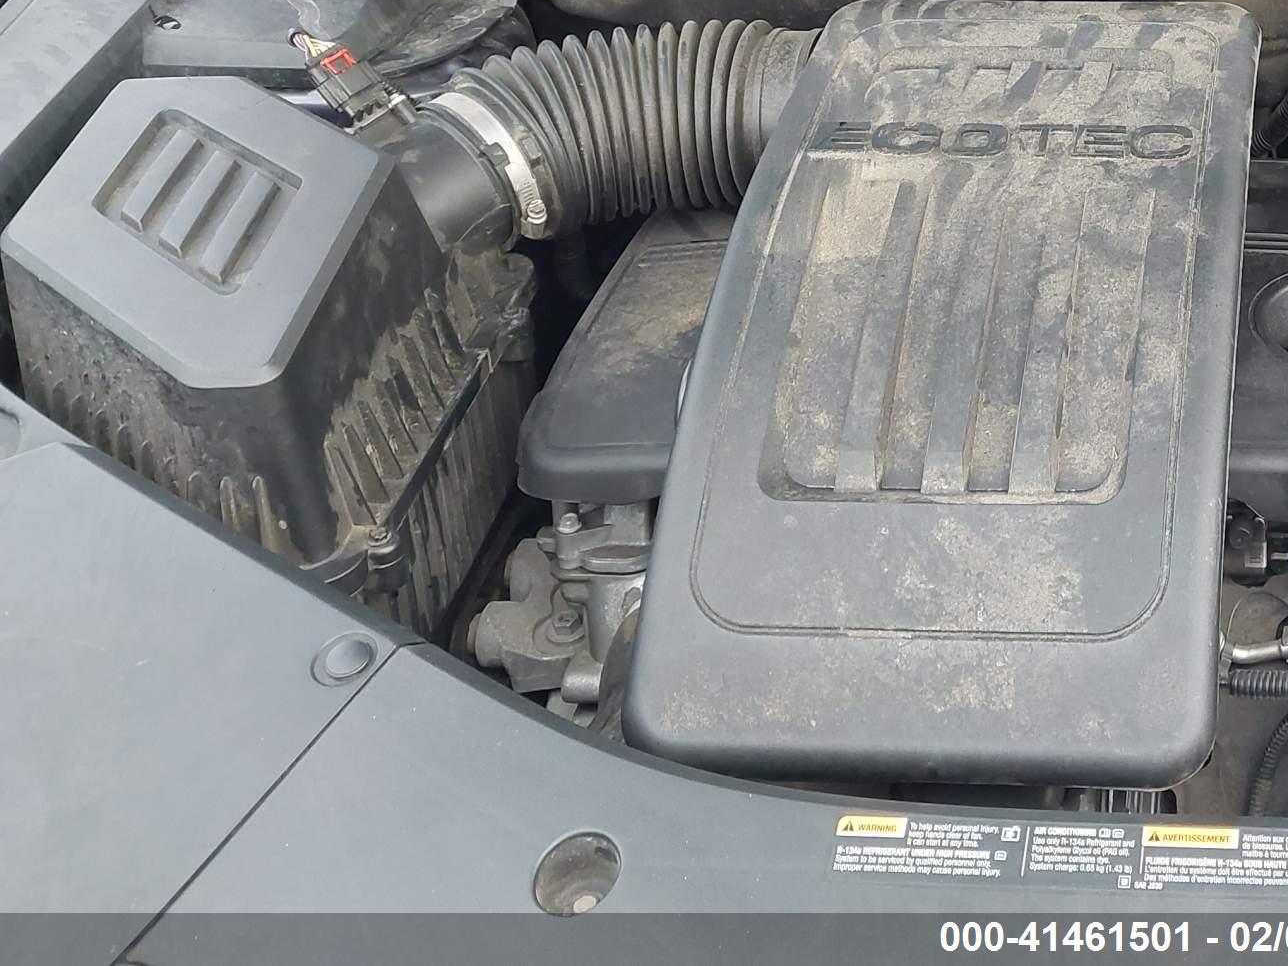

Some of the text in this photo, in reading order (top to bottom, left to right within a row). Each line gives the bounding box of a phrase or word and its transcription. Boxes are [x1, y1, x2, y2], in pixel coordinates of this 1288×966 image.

[807, 122, 1194, 160] ECOTEC
[858, 823, 897, 832] WARNING
[910, 822, 917, 830] To
[1162, 833, 1230, 843] AVERTISSEMENT
[1122, 840, 1135, 848] and
[835, 855, 859, 864] System
[833, 863, 863, 872] Improper
[1029, 861, 1053, 871] System
